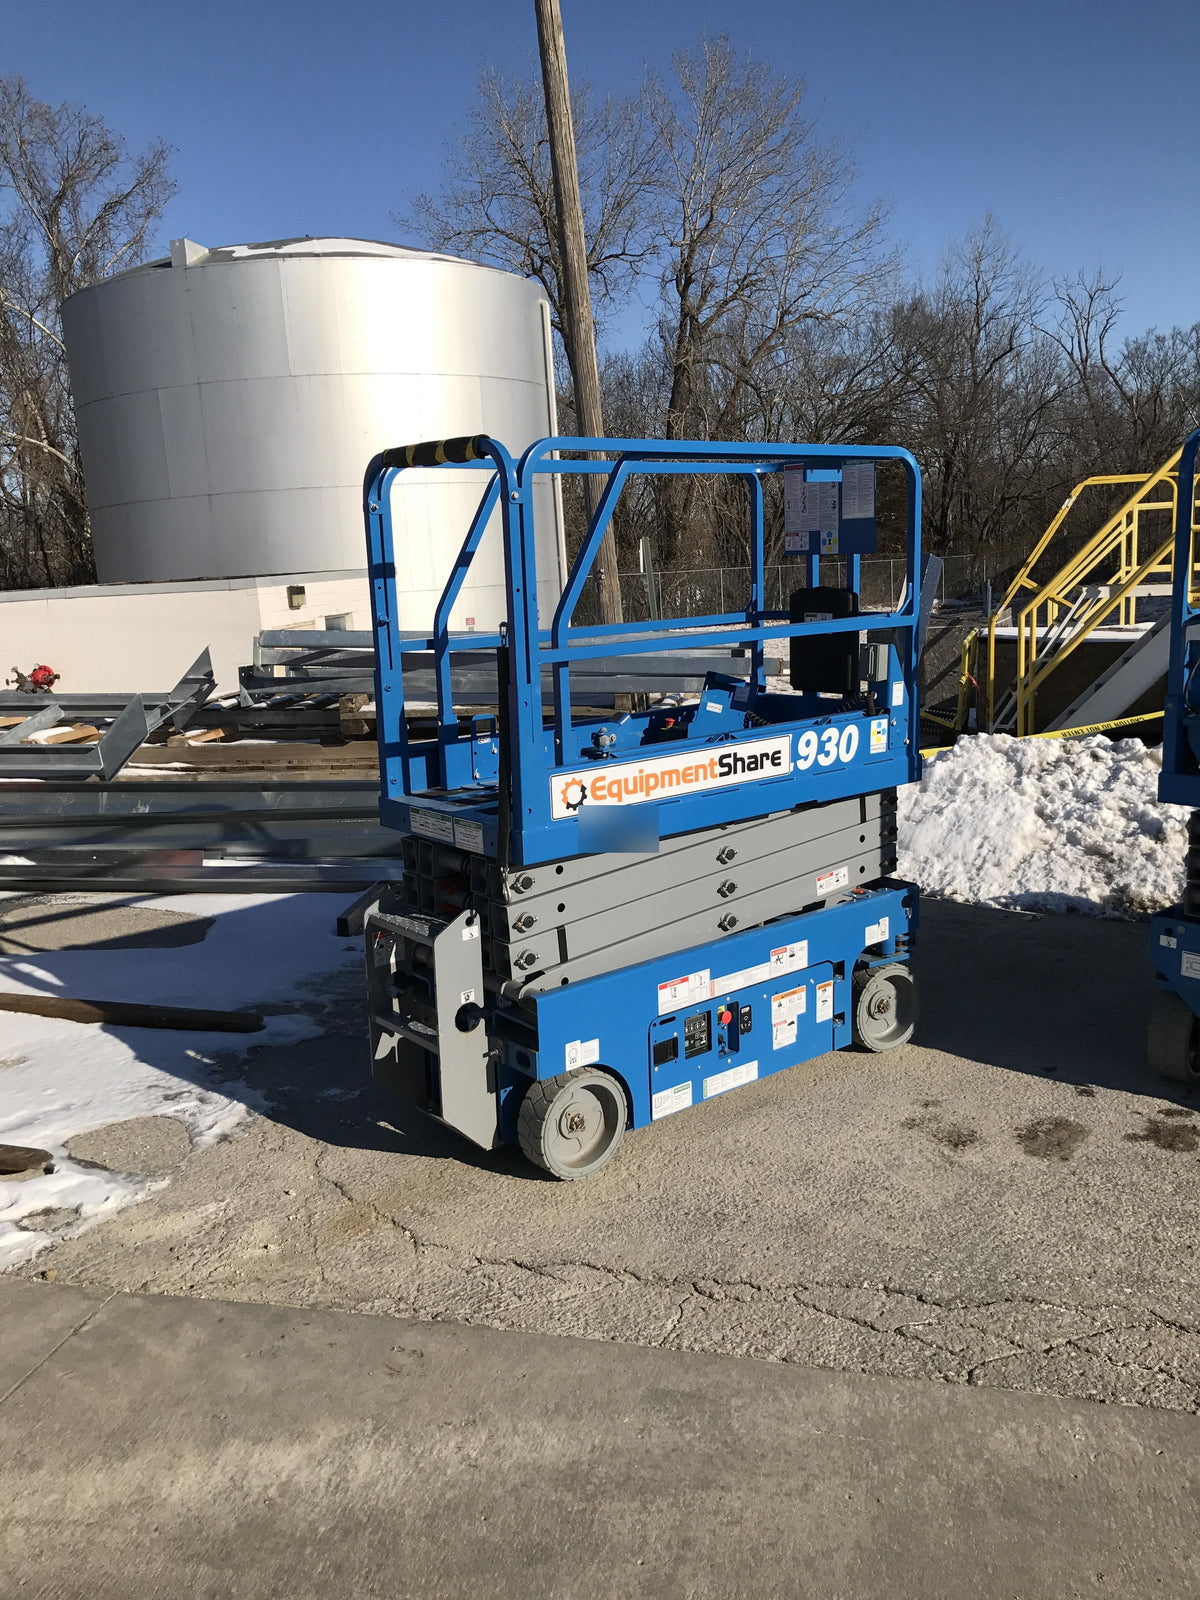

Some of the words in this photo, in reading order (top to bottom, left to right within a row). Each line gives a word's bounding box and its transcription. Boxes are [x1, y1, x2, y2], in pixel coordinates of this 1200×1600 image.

[1061, 729, 1085, 737] ENTER
[1114, 717, 1145, 727] CAUTION
[790, 724, 859, 772] 930
[590, 750, 782, 803] EquipmentShare
